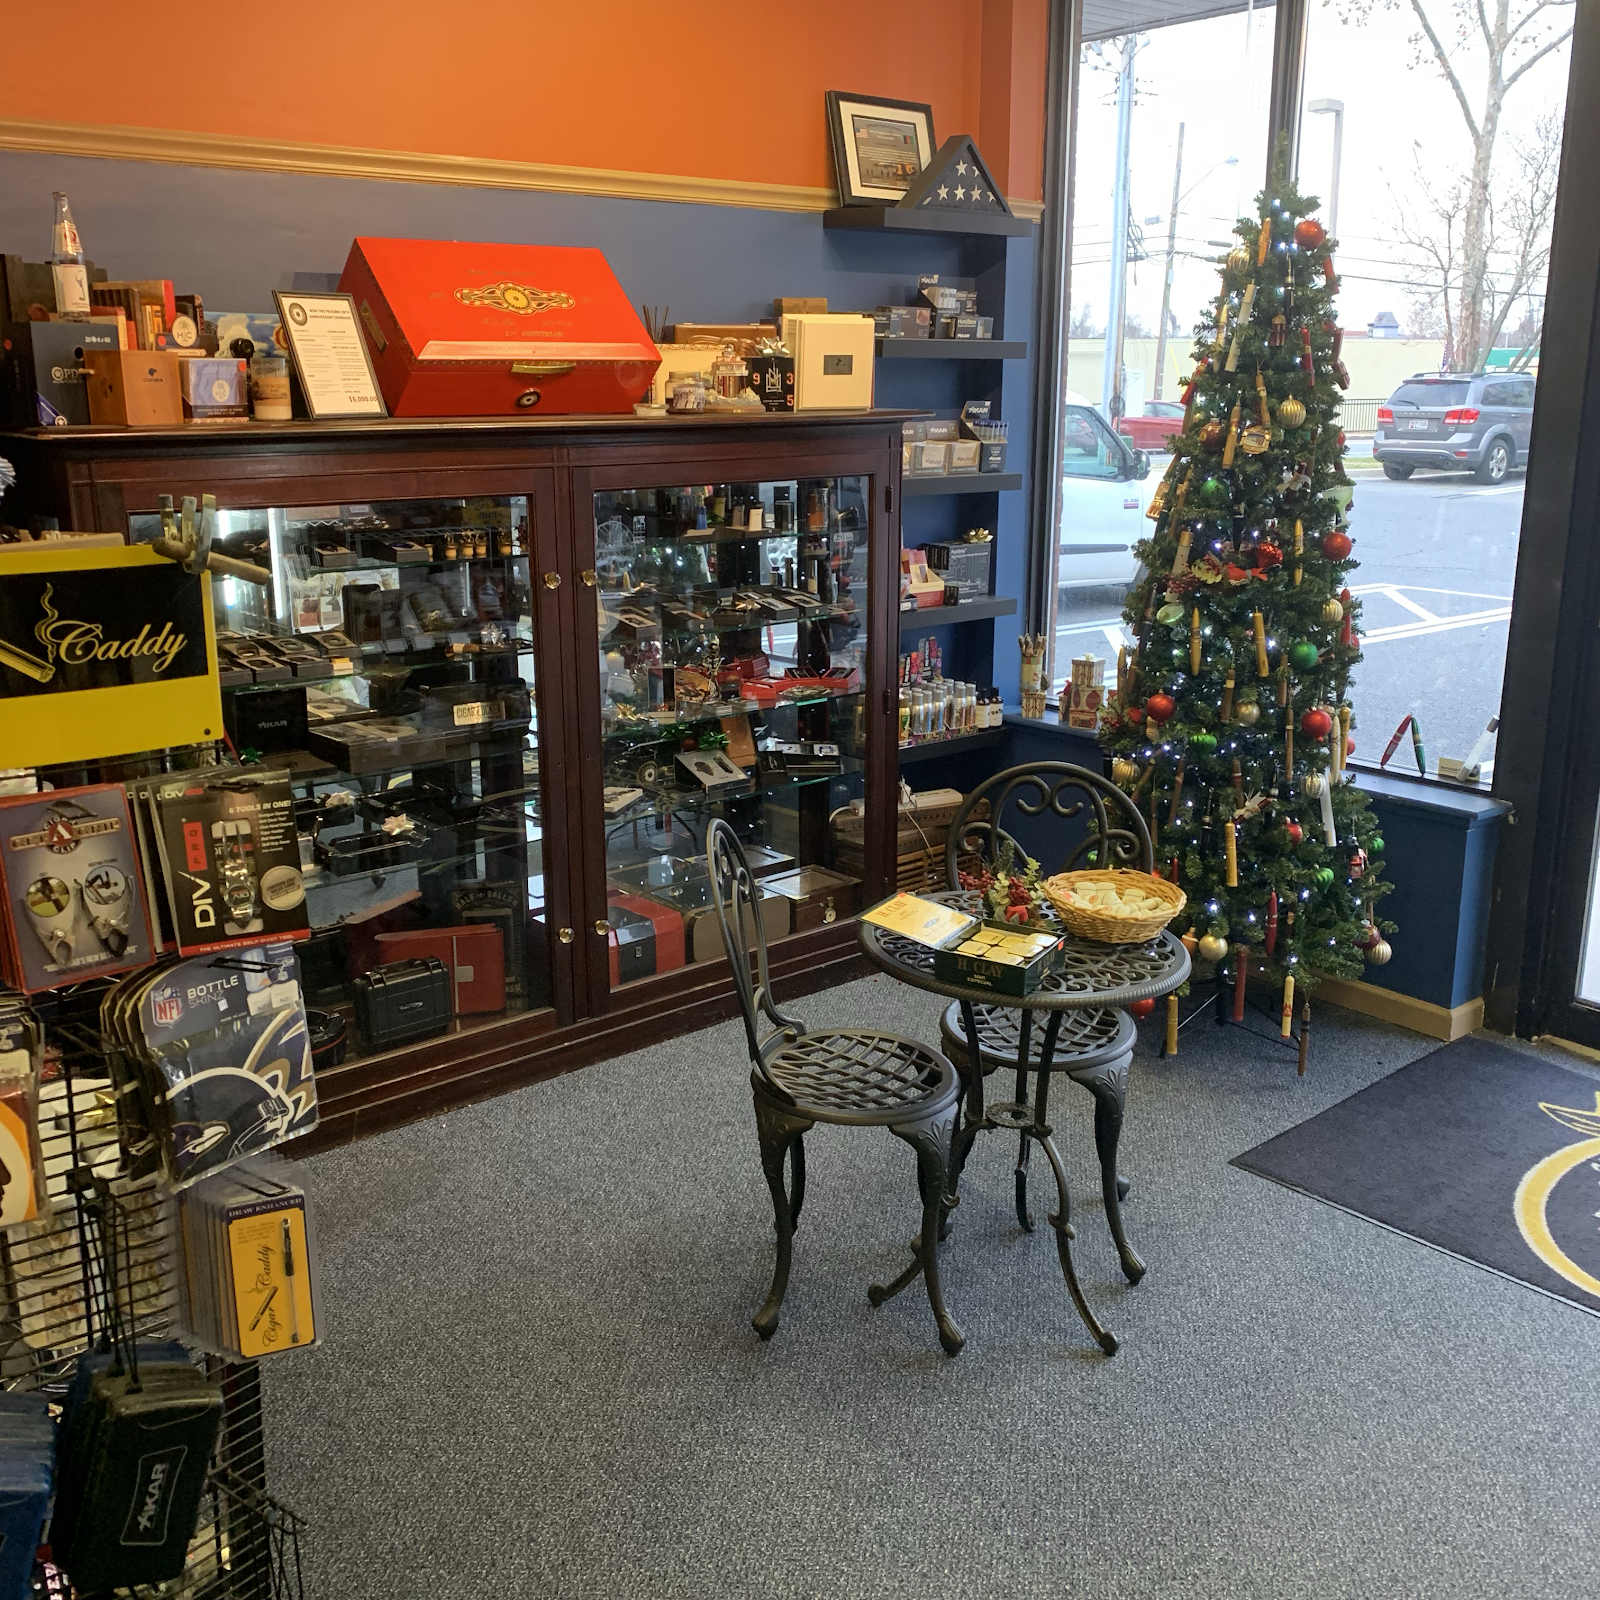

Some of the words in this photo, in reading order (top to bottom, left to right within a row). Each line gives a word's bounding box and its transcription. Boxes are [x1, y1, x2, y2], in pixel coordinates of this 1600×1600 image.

[753, 373, 760, 385] 9
[786, 373, 794, 385] 3
[786, 394, 794, 406] 5
[968, 406, 989, 414] XIKAR
[50, 620, 187, 673] Caddy
[457, 707, 476, 718] CIGAR
[258, 720, 288, 729] XIKAR
[164, 788, 185, 798] DIV
[236, 803, 261, 812] TOOLS
[262, 802, 272, 810] IN
[273, 800, 292, 808] ONE!
[52, 824, 72, 842] A
[52, 842, 76, 853] CLIP
[190, 829, 202, 865] PRO
[178, 871, 216, 928] DIV
[886, 900, 908, 914] CLAY
[212, 942, 242, 951] ULTIMATE
[974, 962, 1004, 978] CLAY
[188, 974, 239, 1000] BOTTLE
[967, 977, 993, 987] ESPECIAL
[188, 990, 225, 1009] SKINZ
[156, 998, 182, 1021] NFL
[228, 1207, 253, 1218] DRAW
[255, 1198, 302, 1212] ENHANCER
[256, 1244, 276, 1294] Caddy
[262, 1306, 283, 1348] Cigar
[137, 1464, 167, 1532] XIKAR
